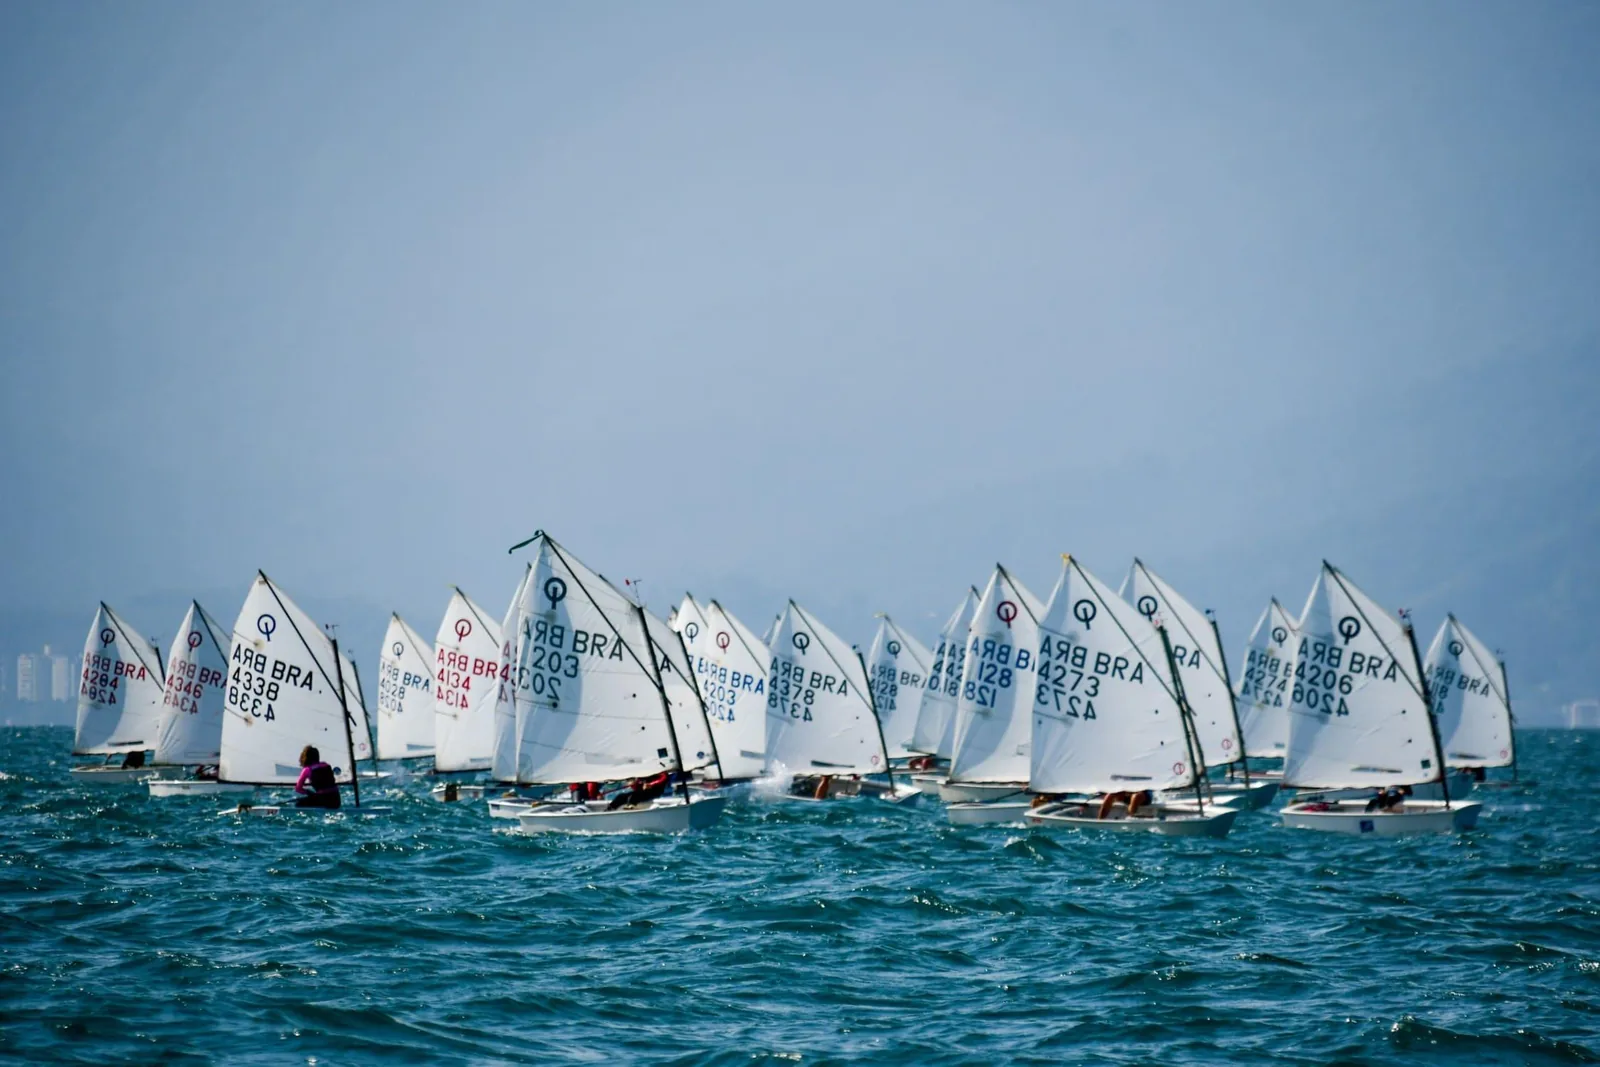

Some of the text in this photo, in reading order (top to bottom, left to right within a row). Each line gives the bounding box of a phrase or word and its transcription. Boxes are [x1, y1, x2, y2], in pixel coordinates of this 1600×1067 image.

[572, 629, 623, 661] BRA
[1172, 645, 1200, 669] RA
[114, 661, 146, 681] BRA
[271, 660, 313, 691] BRA
[472, 658, 498, 680] BR
[533, 646, 579, 679] 203
[978, 661, 1013, 688] 128
[1094, 651, 1144, 685] BRA
[1349, 651, 1396, 683] BRA
[167, 674, 203, 699] 4346
[232, 667, 279, 701] 4338
[403, 671, 429, 692] BRA
[438, 668, 470, 691] 4134
[731, 671, 764, 695] BRA
[769, 676, 815, 705] 4378
[810, 671, 848, 697] BRA
[1037, 660, 1100, 698] 4273
[1245, 667, 1287, 692] 4274
[1295, 661, 1353, 696] 4206
[1457, 674, 1489, 698] BRA
